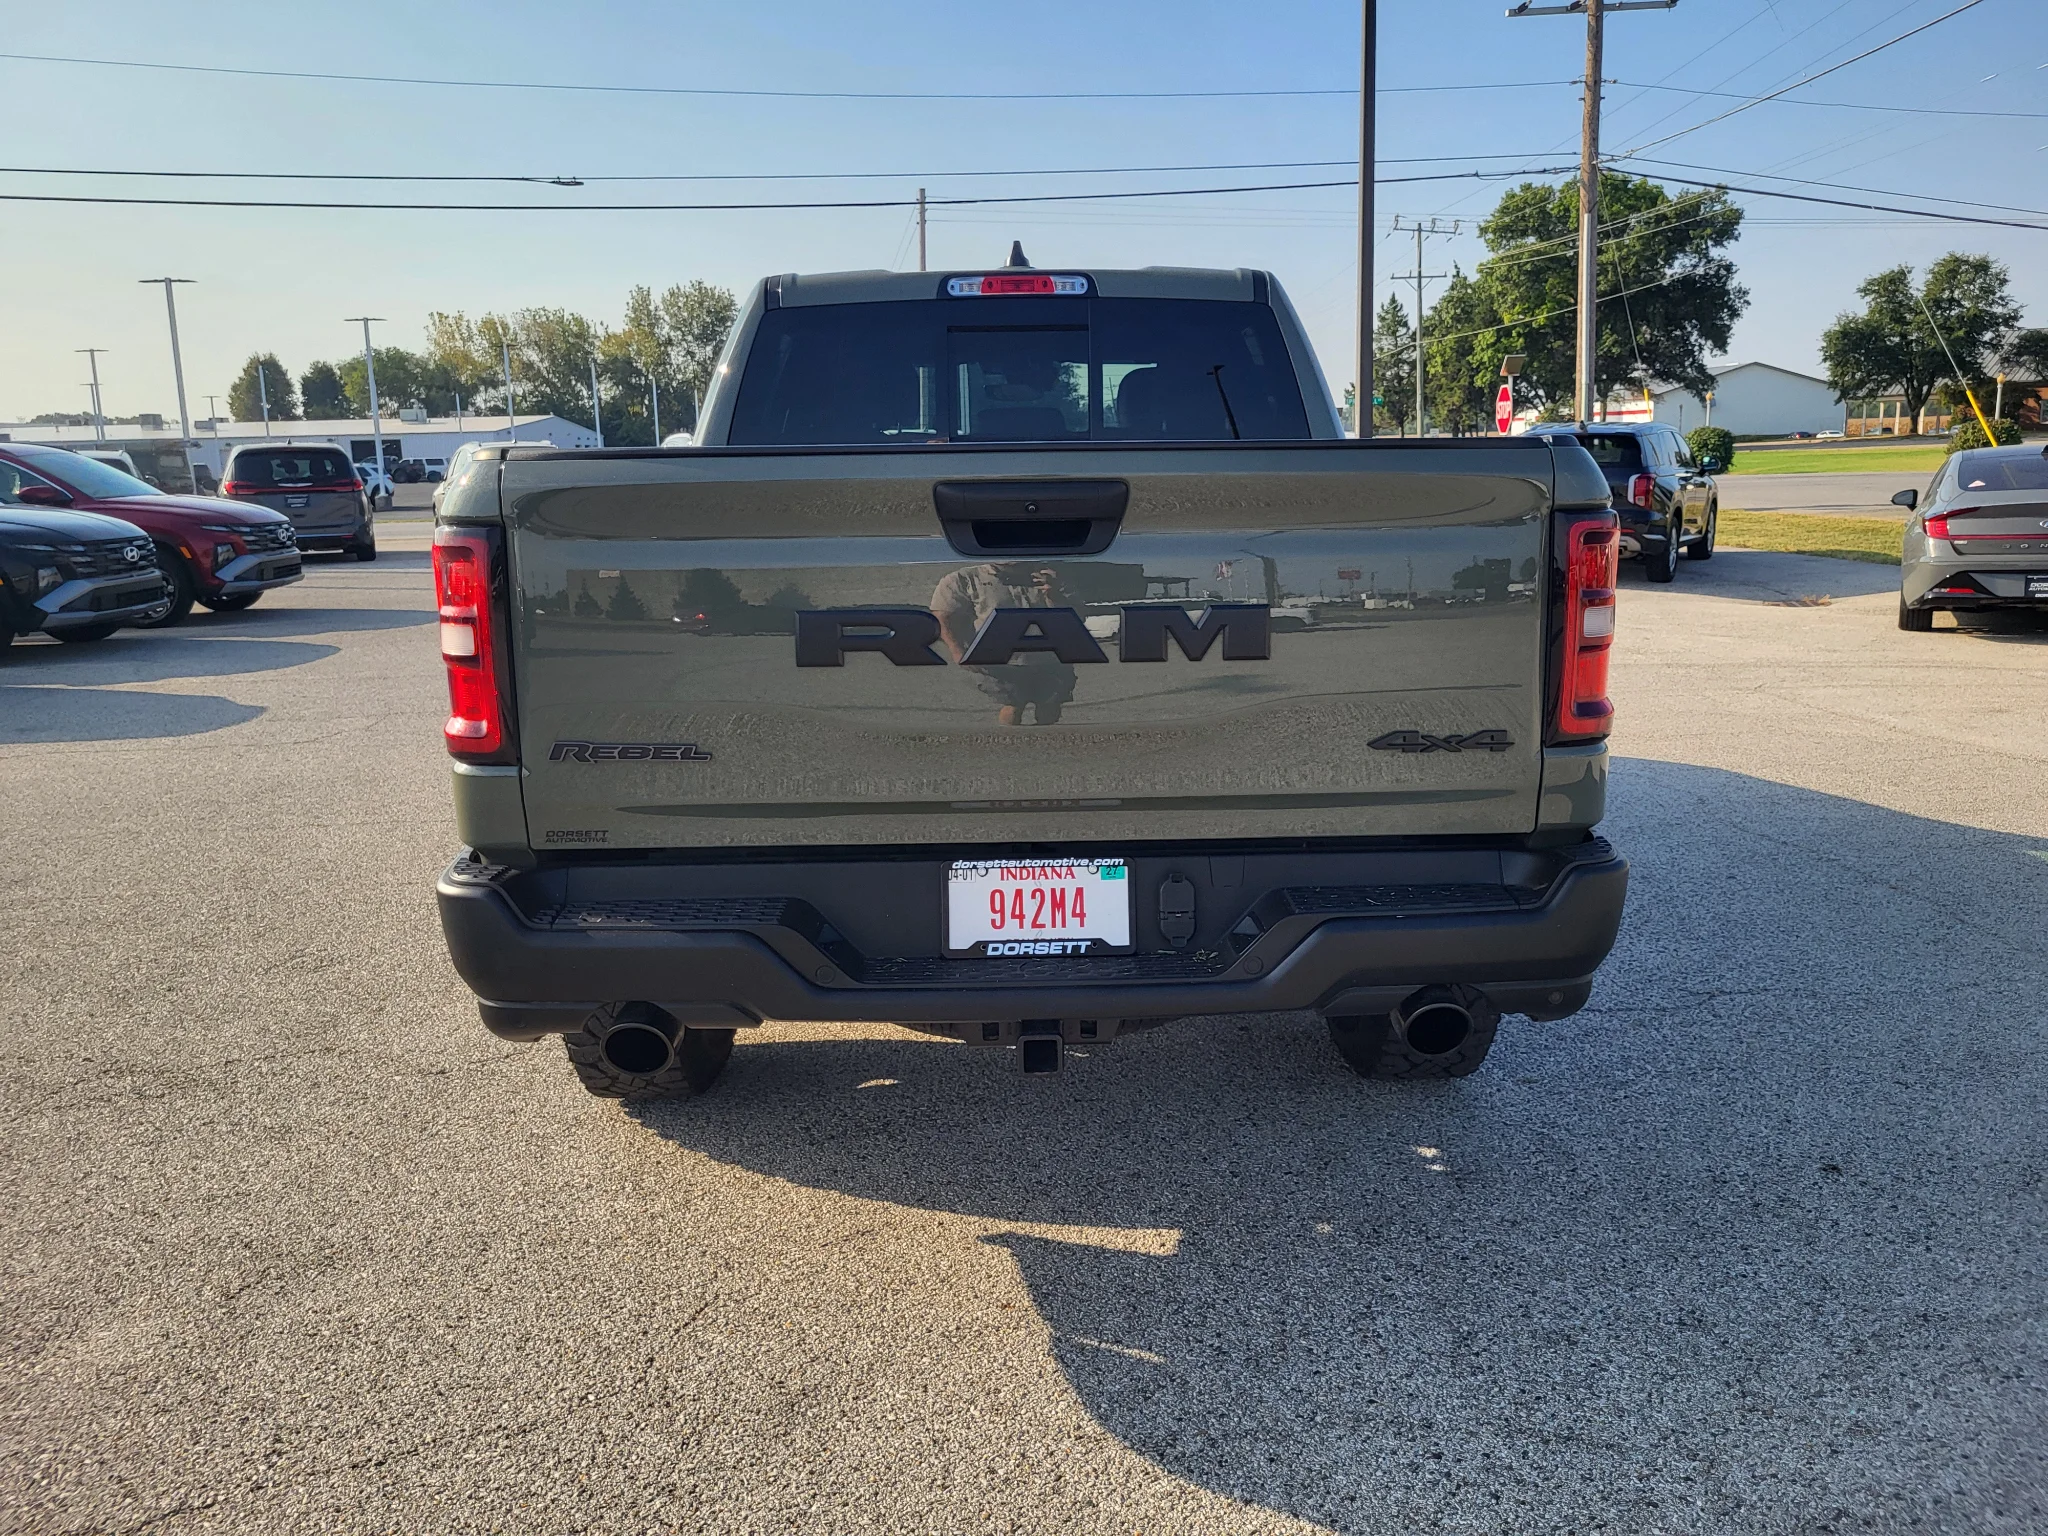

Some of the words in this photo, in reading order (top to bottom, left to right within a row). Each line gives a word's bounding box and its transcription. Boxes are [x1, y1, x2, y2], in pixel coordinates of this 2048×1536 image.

[1497, 401, 1511, 419] STOP
[795, 603, 1271, 667] RAM
[549, 740, 713, 764] REBEL
[545, 836, 609, 844] AUTOMOTIVE
[952, 857, 1124, 869] dorsettautomotive.com
[1106, 866, 1118, 875] 27
[1000, 866, 1076, 881] INDIANA
[989, 886, 1087, 930] 942M4
[986, 940, 1092, 956] DORSETT
